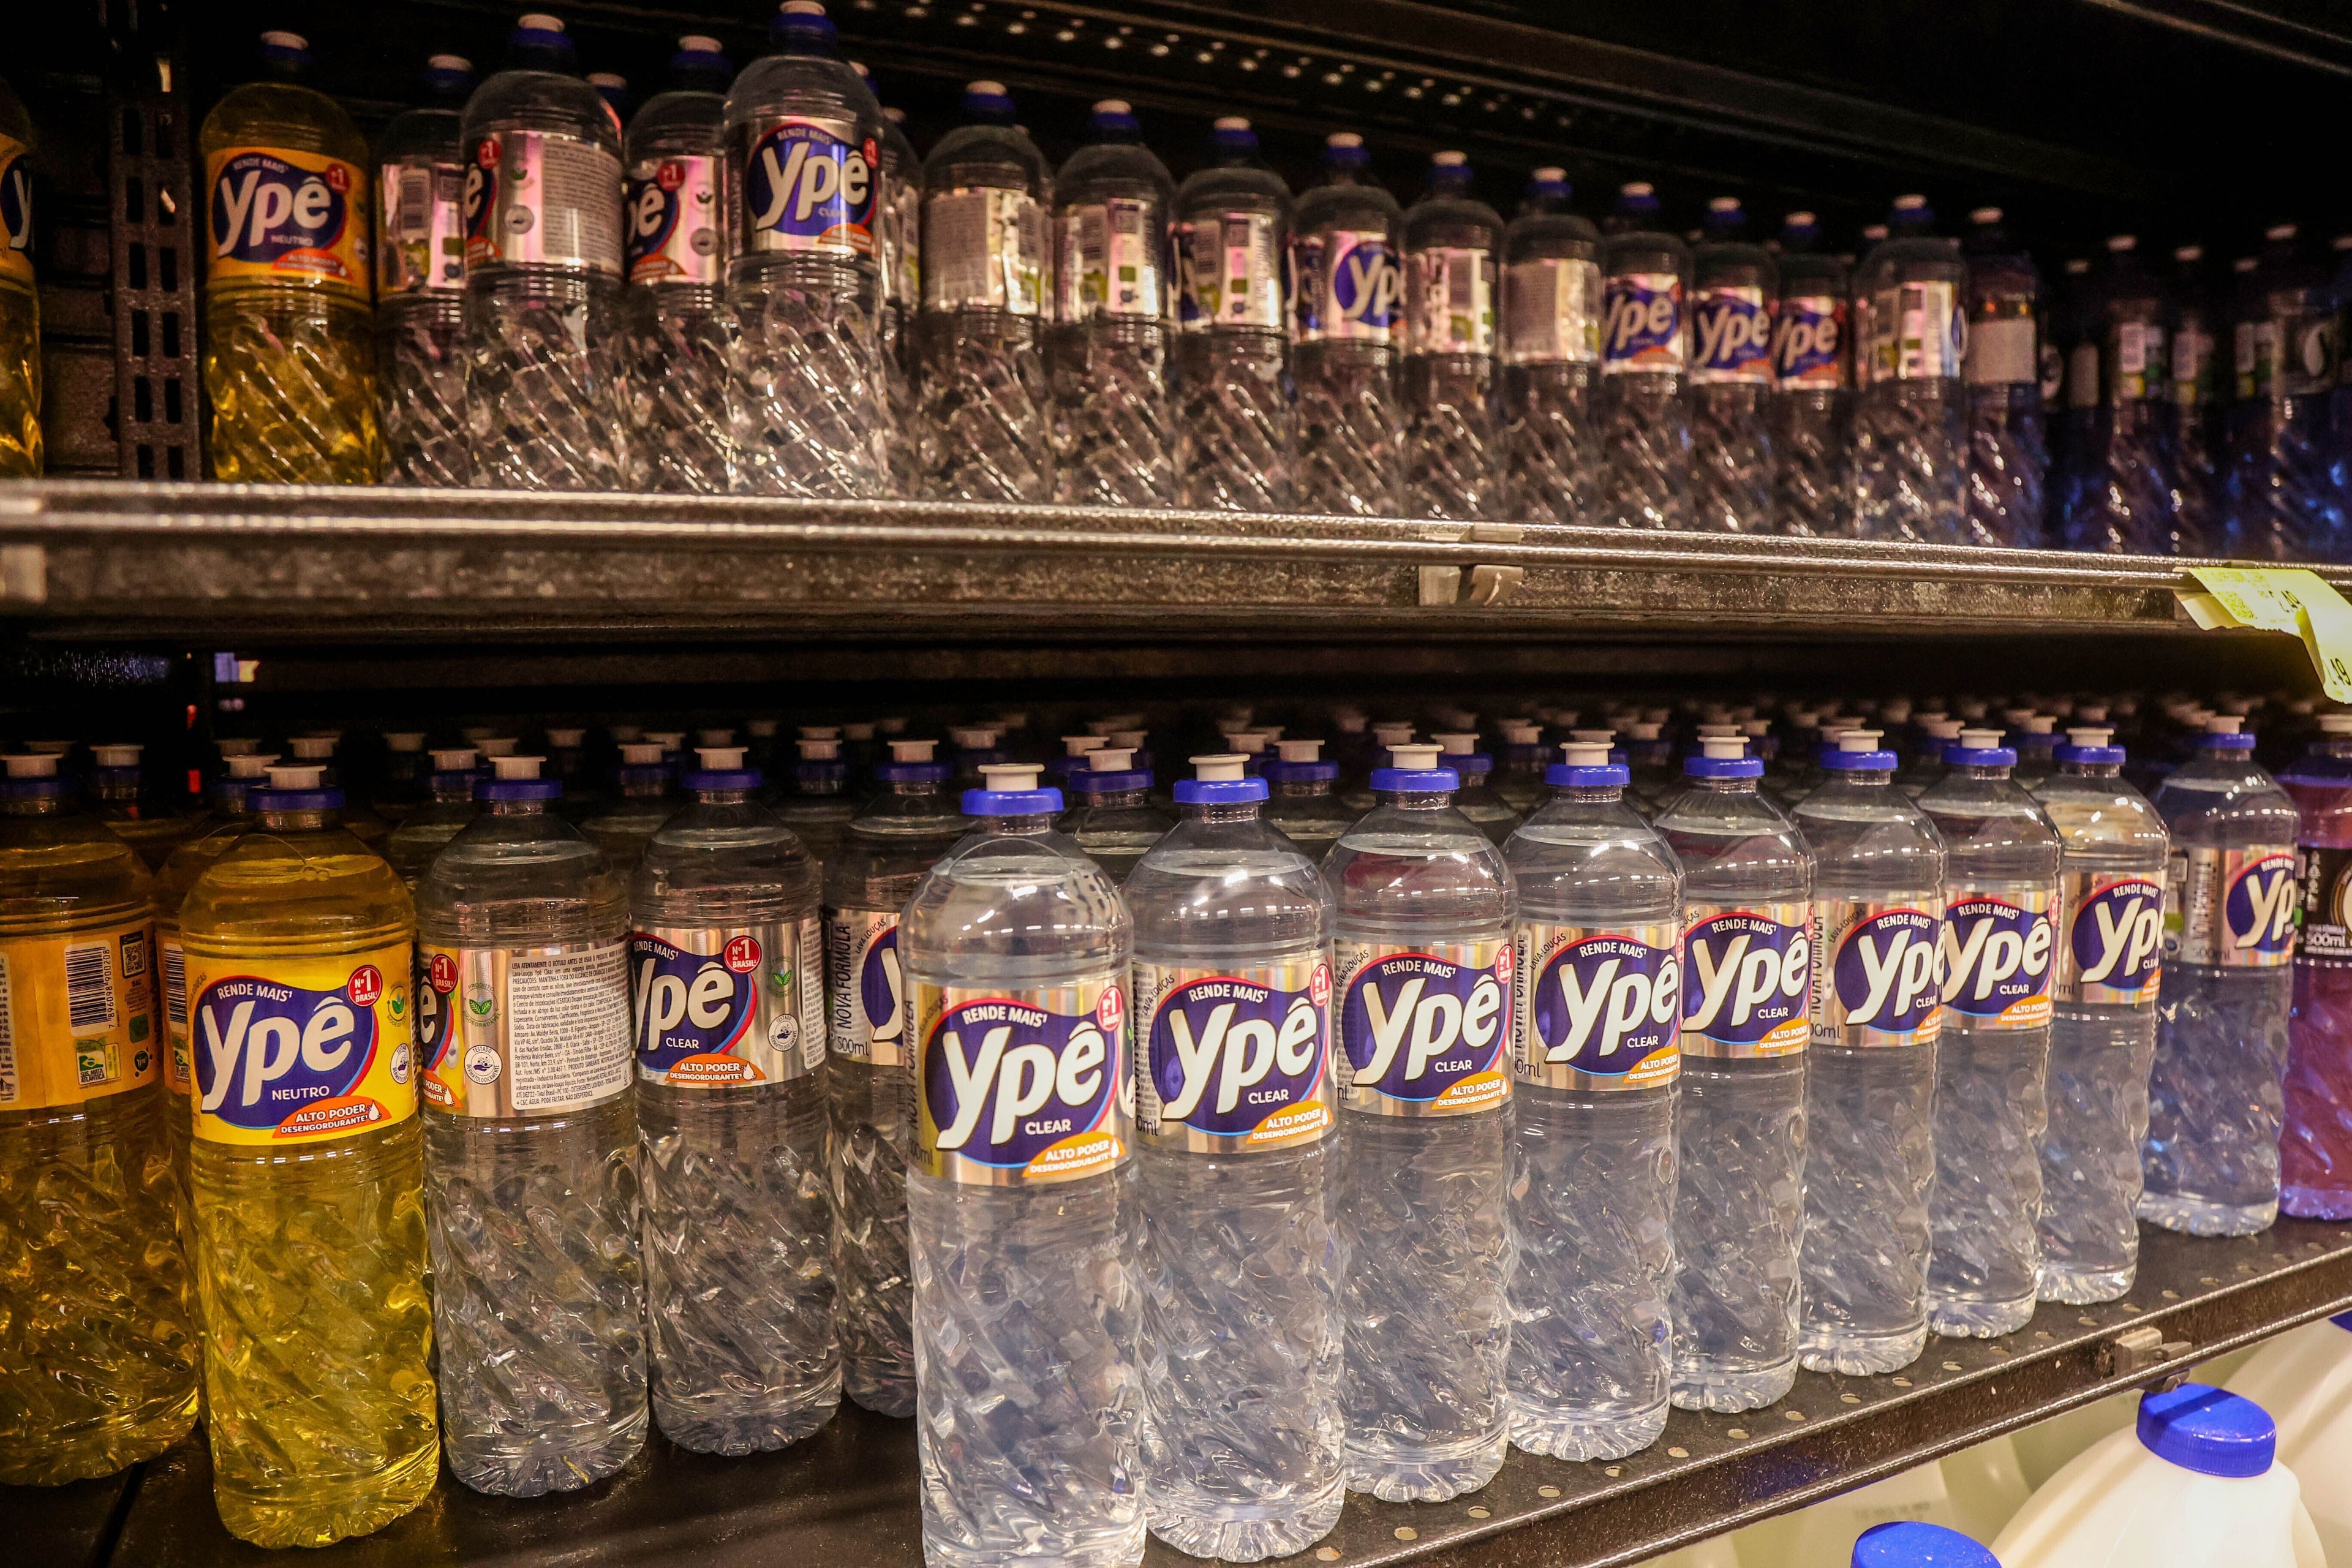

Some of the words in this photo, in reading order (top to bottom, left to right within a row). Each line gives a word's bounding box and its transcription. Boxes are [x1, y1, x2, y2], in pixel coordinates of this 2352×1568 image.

[756, 141, 870, 230] Ypê
[218, 169, 332, 257] Ypê
[2260, 857, 2284, 872] RENDE
[2113, 883, 2141, 899] RENDE
[1958, 903, 1991, 917] RENDE
[2235, 869, 2295, 948] Yp
[1711, 918, 1747, 933] RENDE
[1876, 914, 1909, 930] RENDE
[1529, 932, 1567, 971] LAVA-LOUÇAS
[1578, 941, 1618, 958] RENDE
[1336, 949, 1370, 988] LAVA-LOUÇAS
[1381, 960, 1422, 976] RENDE
[1942, 916, 2052, 1003] Ypê
[2143, 957, 2160, 970] CLEA
[468, 982, 495, 992] PRODUTO
[1681, 930, 1807, 1031] Ypê
[217, 984, 254, 1000] RENDE
[1142, 974, 1175, 1016] LAVA-LOUÇAS
[1188, 984, 1231, 1002] RENDE
[1999, 984, 2030, 996] CLEAR
[1544, 954, 1679, 1063] Ypê
[1915, 995, 1937, 1009] CLEAR
[2011, 1003, 2031, 1014] ALTO
[775, 1015, 793, 1023] TESTADO
[836, 994, 852, 1030] NOVA
[961, 1005, 1006, 1025] RENDE
[1757, 1006, 1789, 1019] CLEAR
[1352, 973, 1500, 1085] Ypê
[1771, 1028, 1790, 1040] ALTO
[1791, 1023, 1808, 1037] PODER
[665, 1037, 699, 1049] CLEAR
[837, 1036, 869, 1057] 500ml
[1627, 1035, 1659, 1048] CLEAR
[201, 996, 355, 1111] Ypê
[1161, 996, 1317, 1120] Ypê
[1640, 1059, 1660, 1071] ALTO
[1660, 1053, 1678, 1066] PODER
[466, 1064, 500, 1083] DERMATOLOGICAMENTE
[680, 1063, 704, 1072] ALTO
[706, 1063, 741, 1072] PODER
[1434, 1059, 1472, 1073] CLEAR
[272, 1085, 330, 1101] NEUTRO
[425, 1079, 443, 1093] PODER
[936, 1020, 1106, 1150] Ypê
[1450, 1082, 1475, 1096] ALTO
[1476, 1078, 1502, 1093] PODER
[1248, 1088, 1289, 1105] CLEAR
[295, 1110, 326, 1123] ALTO
[328, 1103, 367, 1119] PODER
[906, 1082, 919, 1130] NOVA
[1025, 1118, 1072, 1136] CLEAR
[1266, 1115, 1292, 1129] ALTO
[1294, 1107, 1321, 1124] PODER
[1045, 1148, 1076, 1162] ALTO
[1077, 1139, 1110, 1157] PODER
